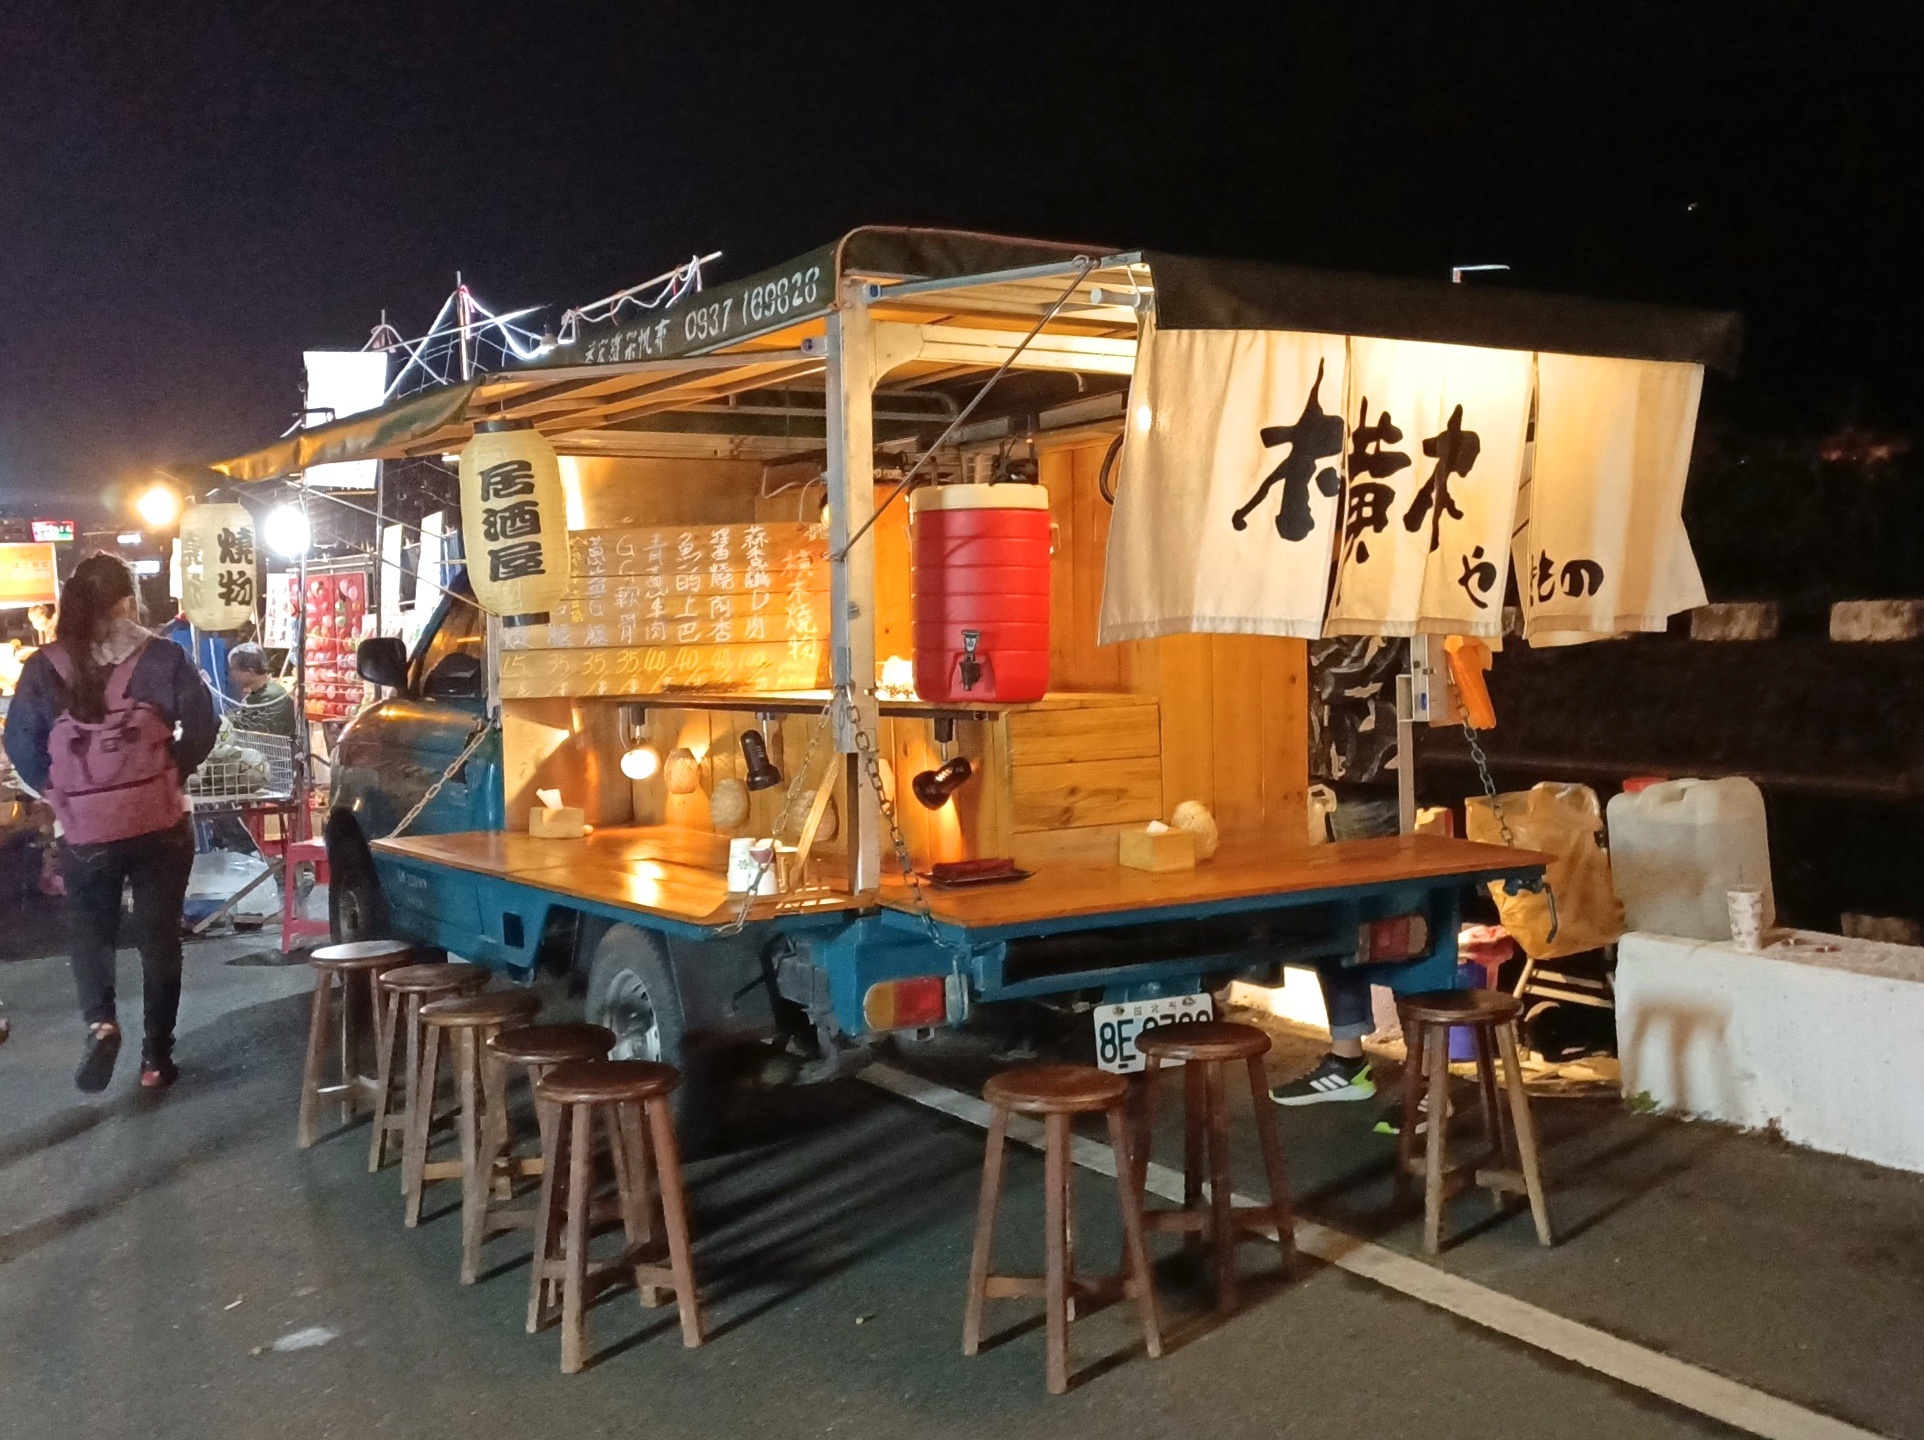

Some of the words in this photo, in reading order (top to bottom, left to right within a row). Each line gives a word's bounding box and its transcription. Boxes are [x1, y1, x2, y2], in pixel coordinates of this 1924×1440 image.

[685, 298, 734, 341] 0937
[477, 459, 546, 583] 居酒屋
